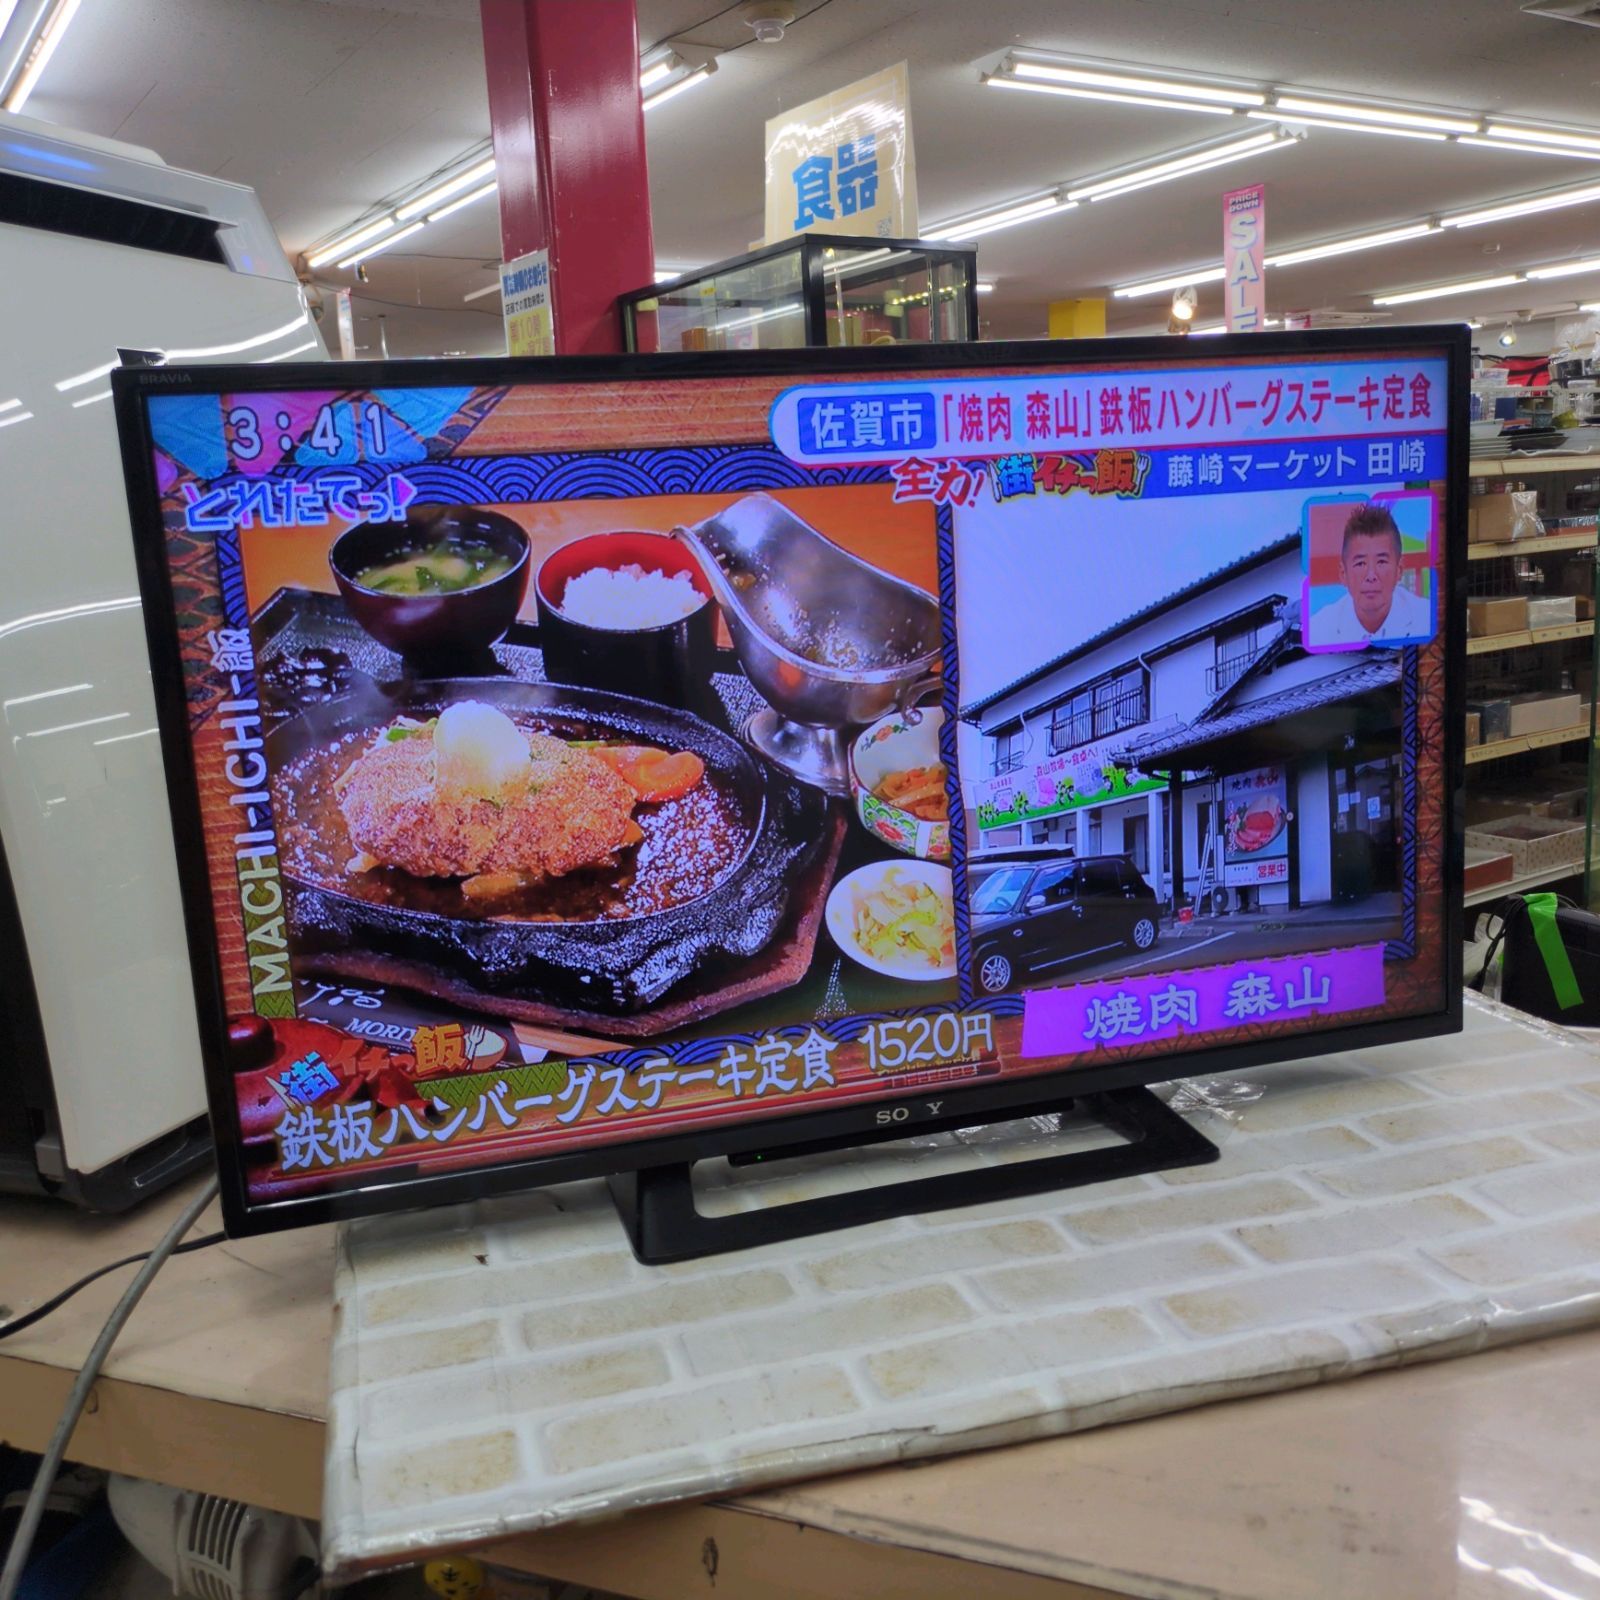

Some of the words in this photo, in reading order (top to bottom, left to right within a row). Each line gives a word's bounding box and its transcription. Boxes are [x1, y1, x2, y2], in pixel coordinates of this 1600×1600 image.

[791, 132, 879, 232] 食器
[1228, 191, 1259, 204] PRICE
[1228, 200, 1259, 213] DOWN
[138, 373, 193, 385] BRAVIA
[227, 401, 388, 461] 3:41
[810, 398, 924, 450] 佐賀市
[942, 392, 1012, 443] 「焼肉
[1025, 372, 1432, 440] 森山」鉄板ハンバーグステーキ定食
[1167, 446, 1357, 488] 藤崎マーケット
[1367, 438, 1427, 477] 田崎
[1257, 862, 1287, 879] 営業中
[1082, 983, 1198, 1040] 焼肉
[1223, 965, 1331, 1019] 森山
[275, 1027, 839, 1171] 鉄板ハンバーグステーキ定食
[857, 1012, 994, 1071] 1520円
[876, 1101, 944, 1125] SOY
